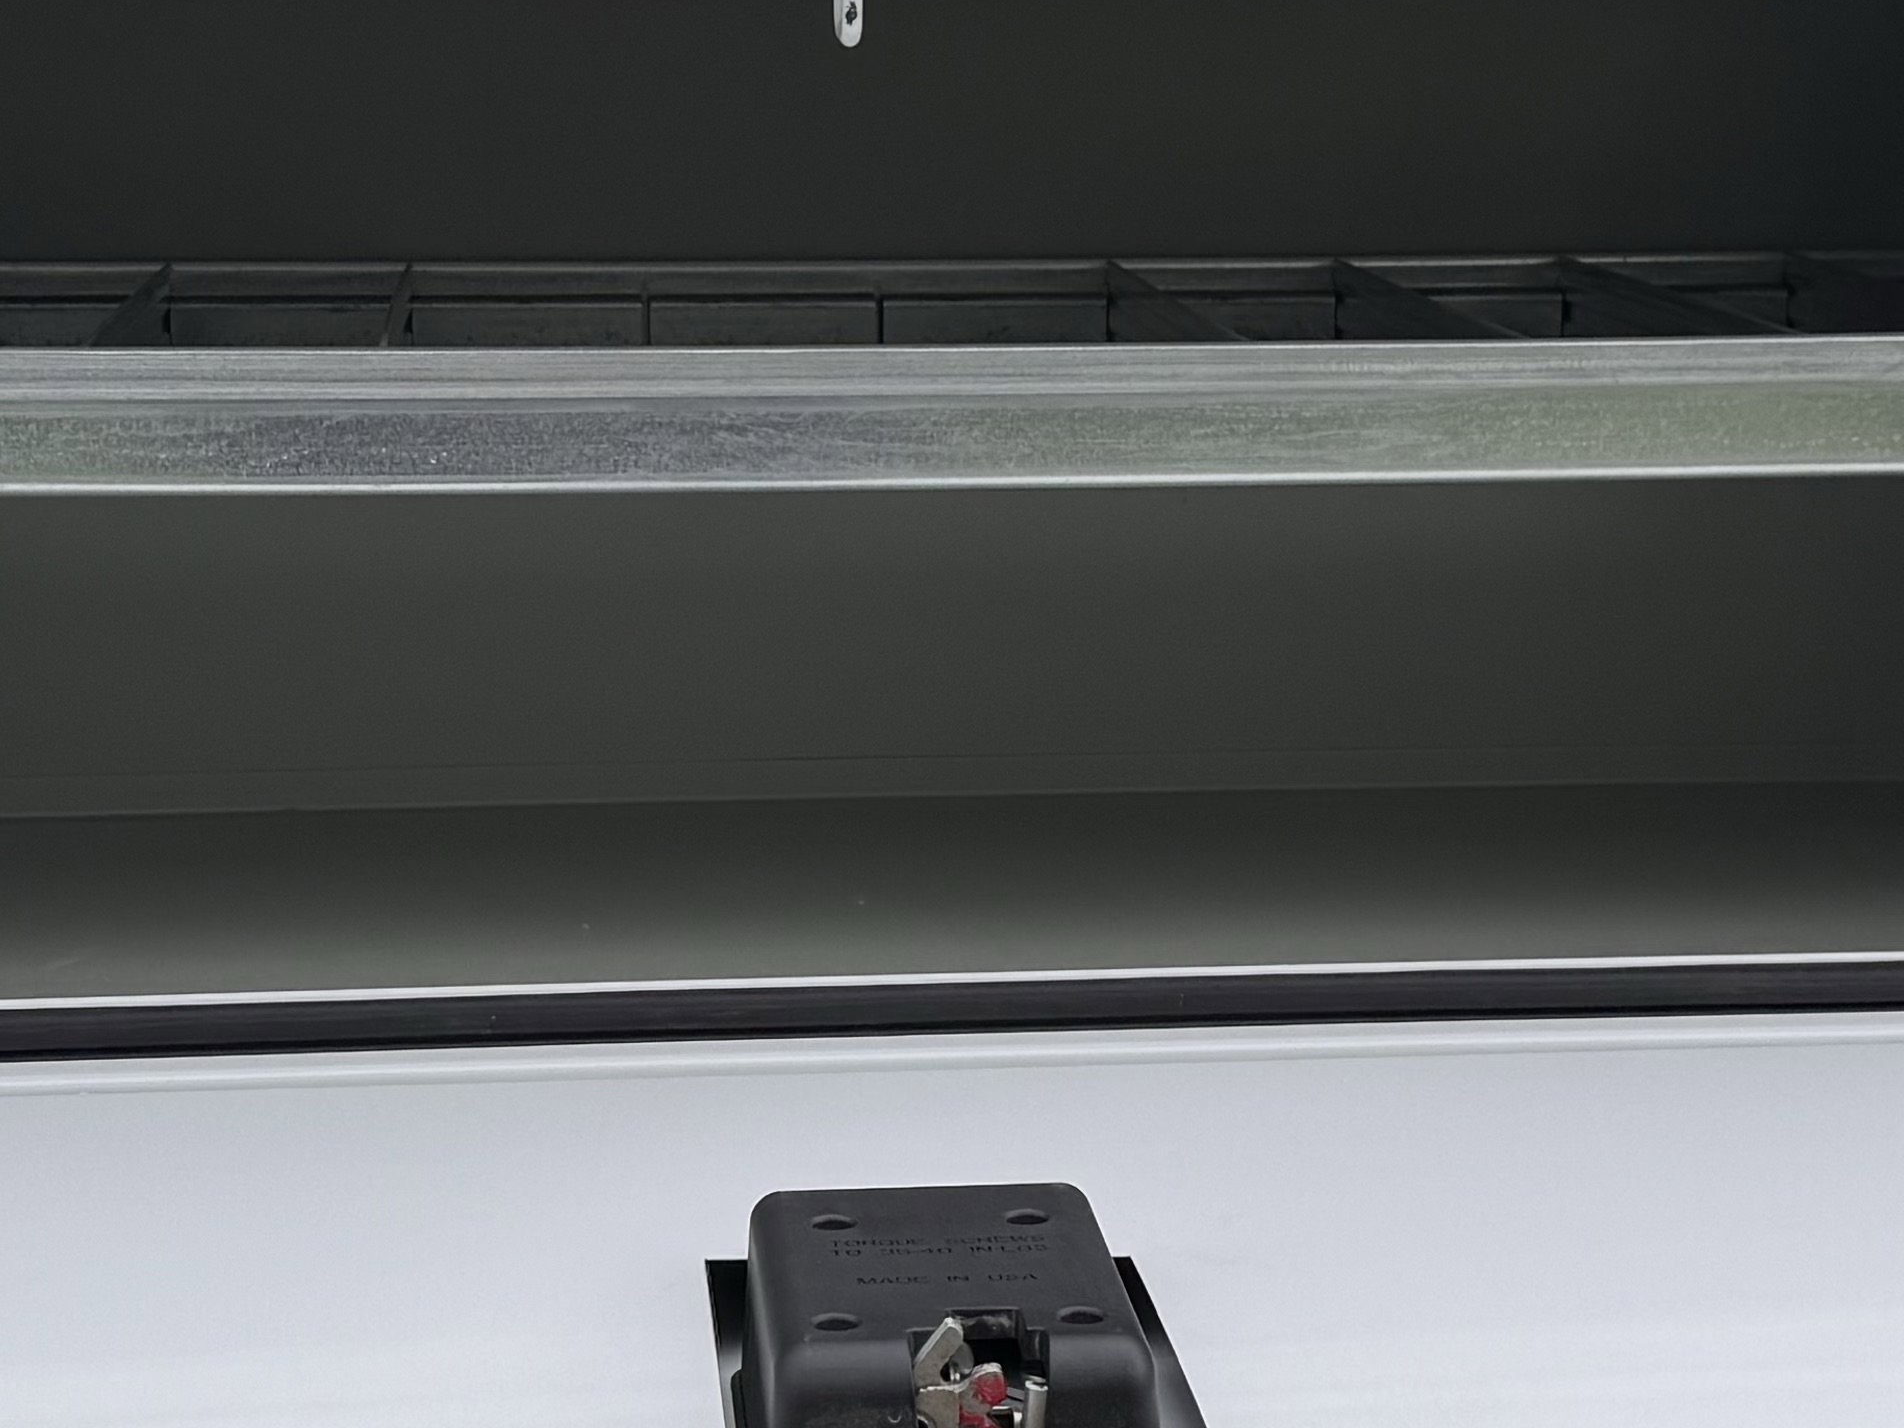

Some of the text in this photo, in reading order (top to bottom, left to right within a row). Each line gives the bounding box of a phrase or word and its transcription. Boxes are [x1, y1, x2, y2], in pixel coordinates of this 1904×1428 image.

[831, 1248, 862, 1257] TO
[856, 1272, 1039, 1285] MADE IN USA
